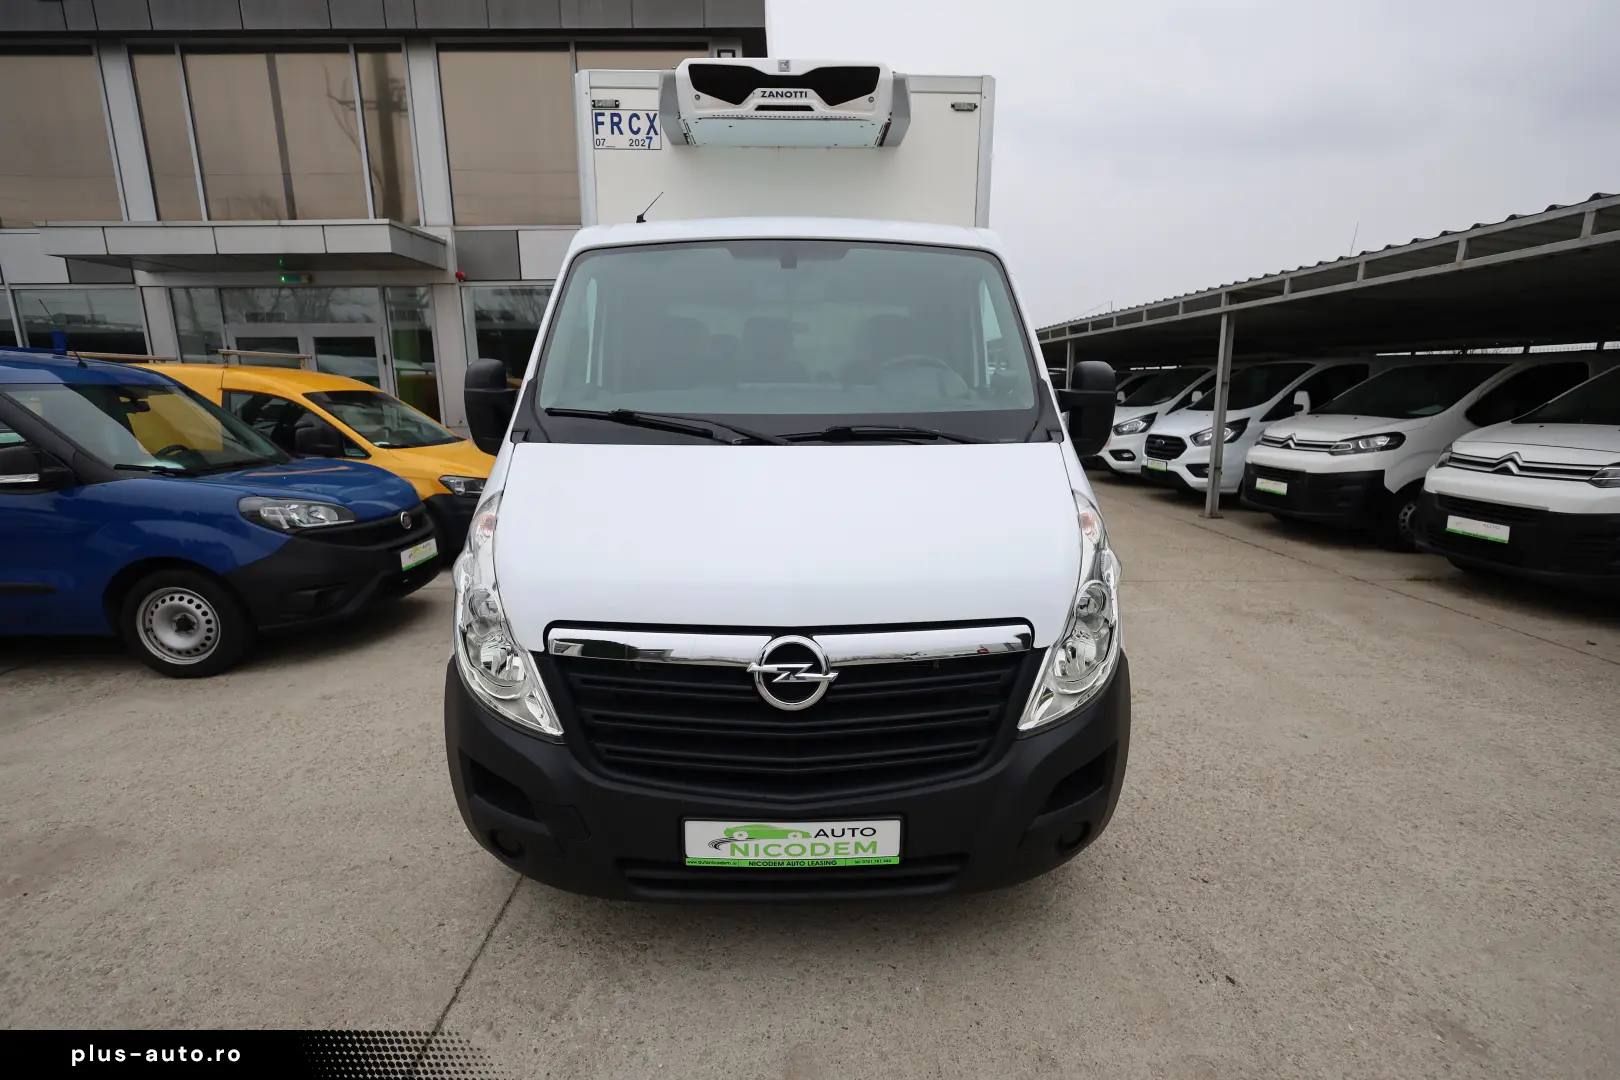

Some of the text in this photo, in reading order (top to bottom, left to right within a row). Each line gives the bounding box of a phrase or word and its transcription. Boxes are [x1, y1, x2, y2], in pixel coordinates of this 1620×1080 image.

[760, 90, 808, 98] ZANOTTI
[594, 112, 659, 136] FRCX
[628, 136, 653, 149] 2027
[813, 827, 877, 839] AUTO
[729, 840, 878, 858] NICODEM
